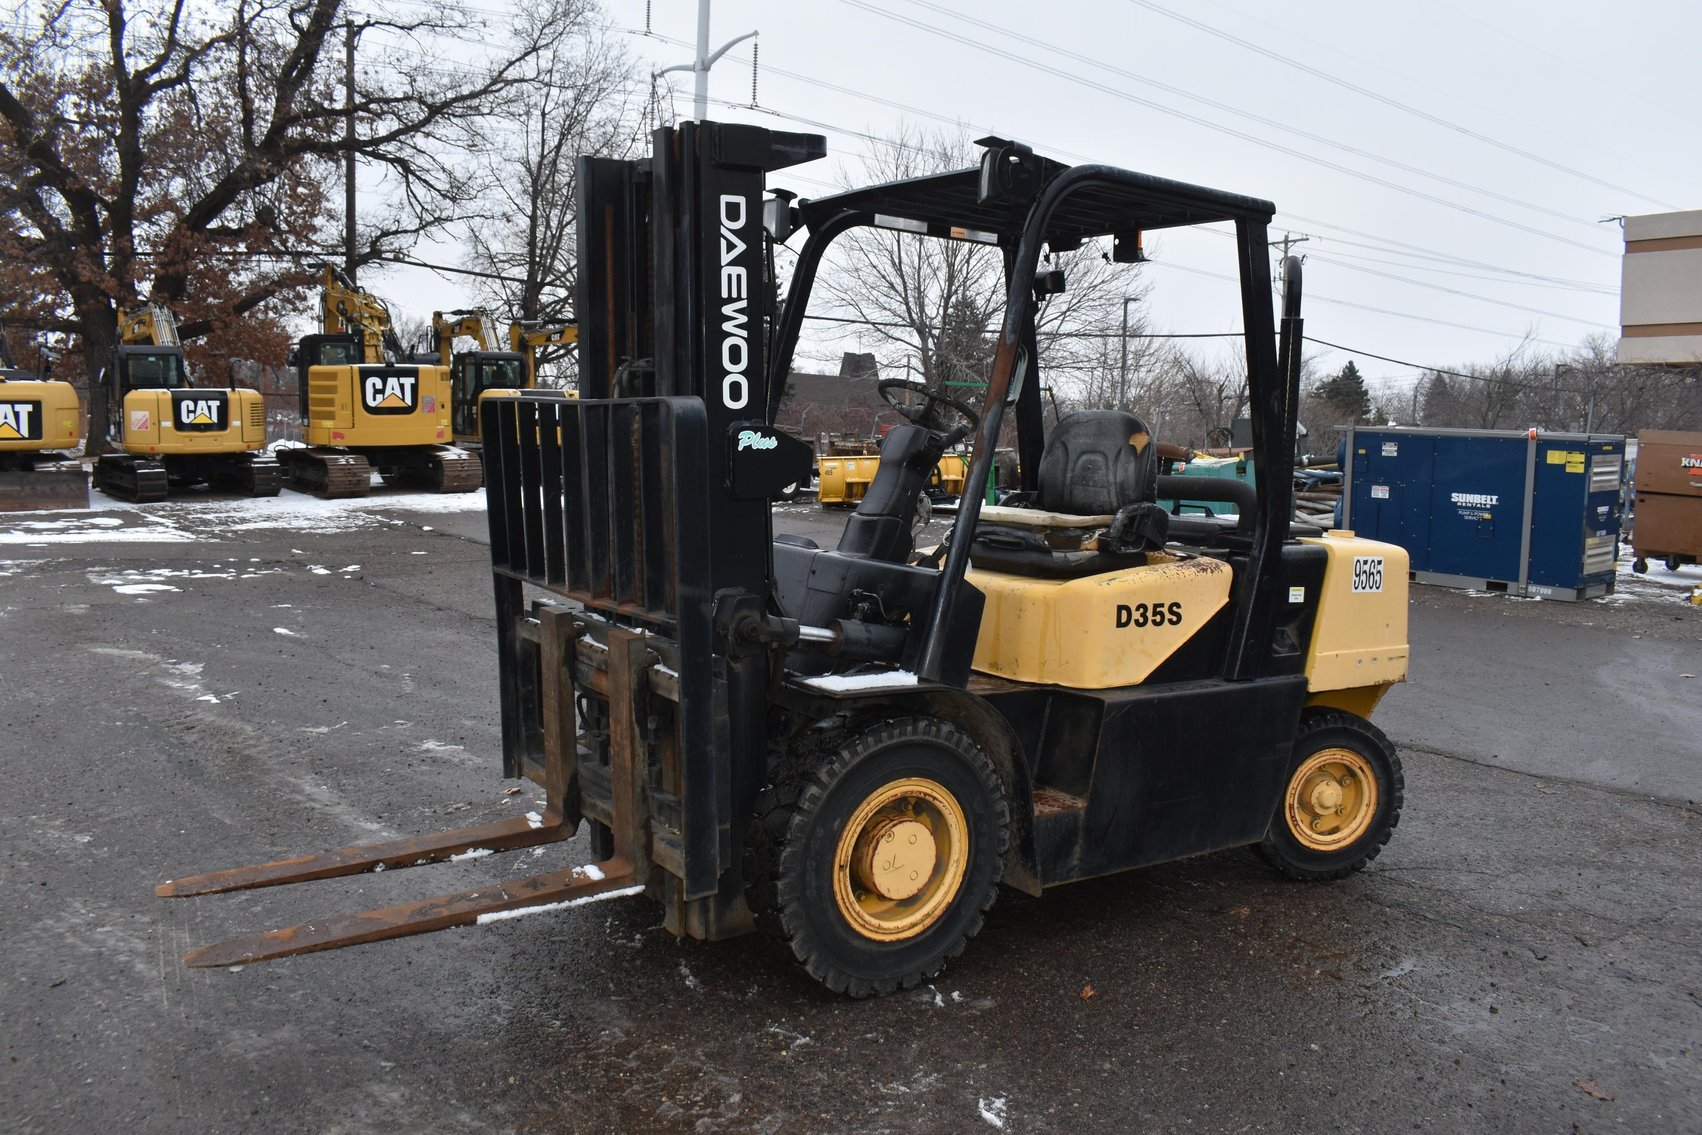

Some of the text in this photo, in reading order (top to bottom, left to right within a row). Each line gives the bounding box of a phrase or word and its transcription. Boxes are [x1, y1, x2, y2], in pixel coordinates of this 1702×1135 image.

[720, 194, 749, 410] DAEWOO
[365, 376, 415, 407] CAT
[180, 400, 220, 423] CAT
[737, 430, 778, 451] Plus
[1680, 457, 1702, 468] KN
[1451, 492, 1499, 505] SUNBELT
[1353, 559, 1383, 590] 9565
[1116, 602, 1182, 628] D35S
